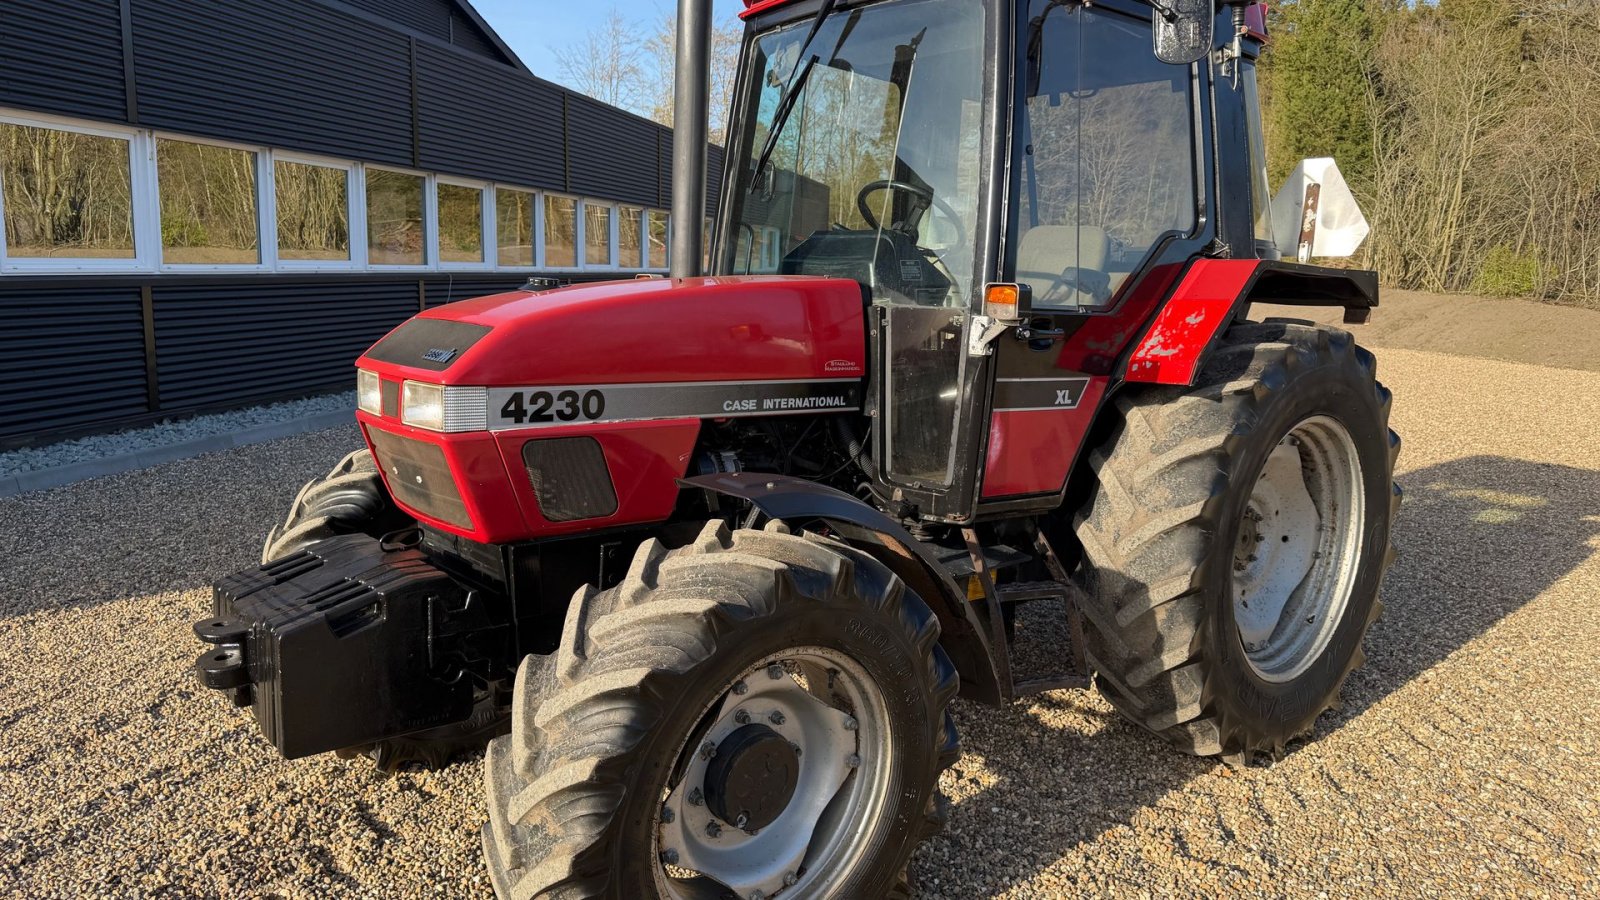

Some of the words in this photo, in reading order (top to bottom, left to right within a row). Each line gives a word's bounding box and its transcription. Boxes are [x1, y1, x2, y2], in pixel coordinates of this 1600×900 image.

[723, 399, 758, 411] CASE
[763, 396, 846, 409] INTERNATIONAL
[1054, 389, 1072, 405] XL
[500, 389, 606, 424] 4230
